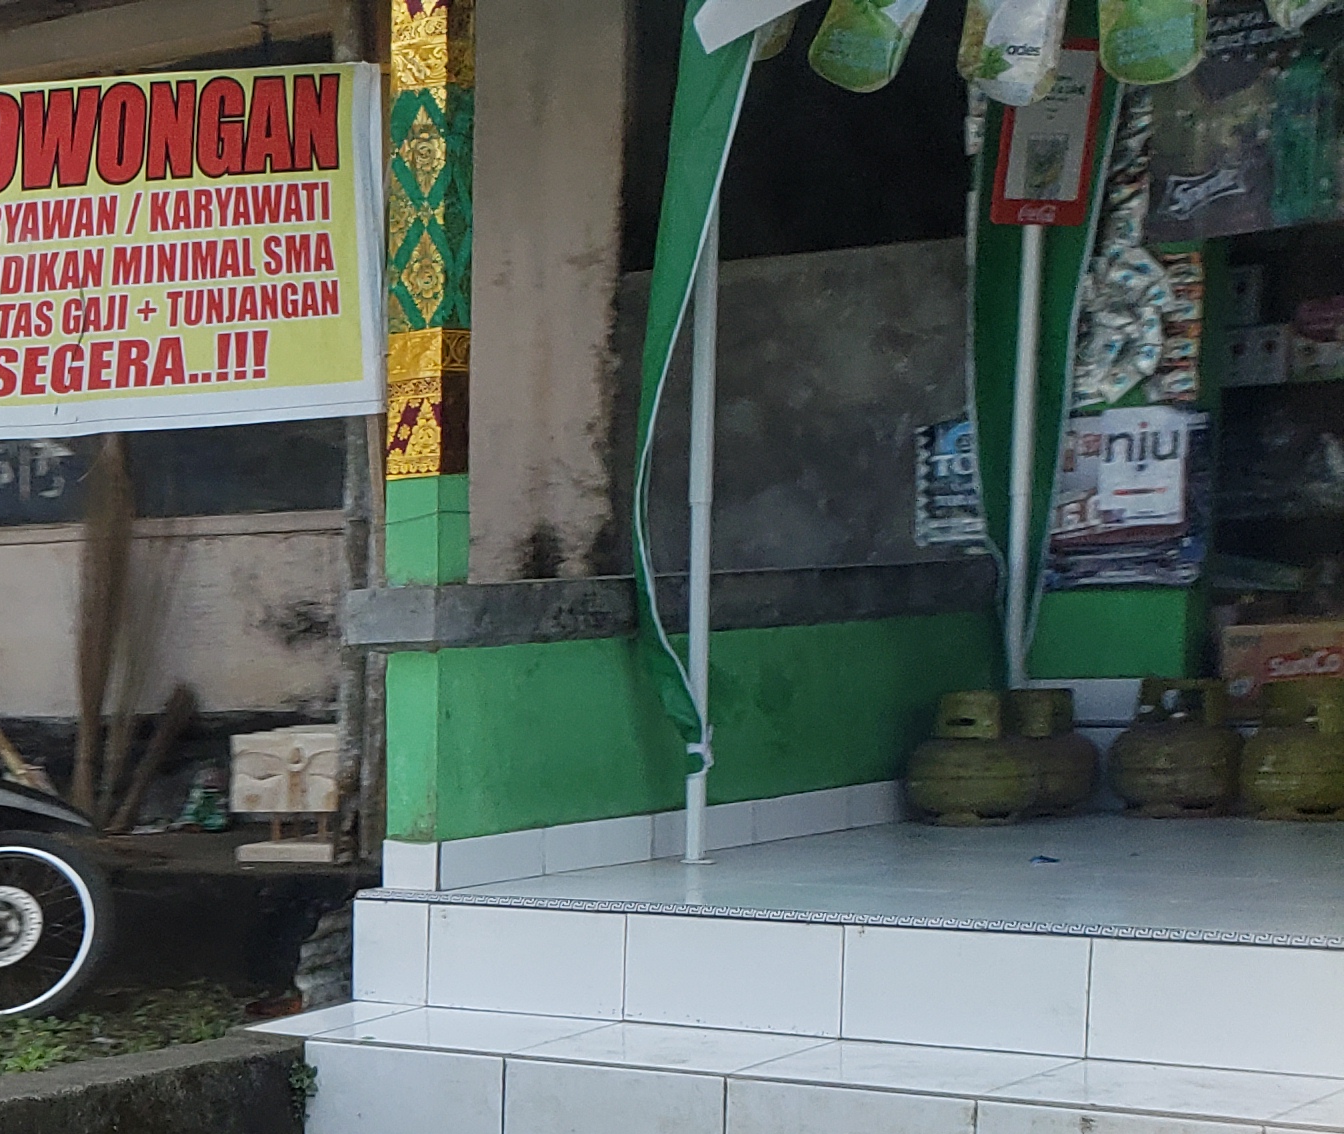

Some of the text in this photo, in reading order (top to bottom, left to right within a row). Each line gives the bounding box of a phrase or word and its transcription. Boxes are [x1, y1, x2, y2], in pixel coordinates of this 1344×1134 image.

[125, 192, 142, 235] /
[150, 182, 330, 231] KARYAWATI
[112, 238, 254, 285] MINIMAL
[264, 233, 334, 275] SMA
[62, 294, 128, 335] GAJI
[137, 300, 157, 321] +
[167, 280, 339, 327] TUNJANGAN
